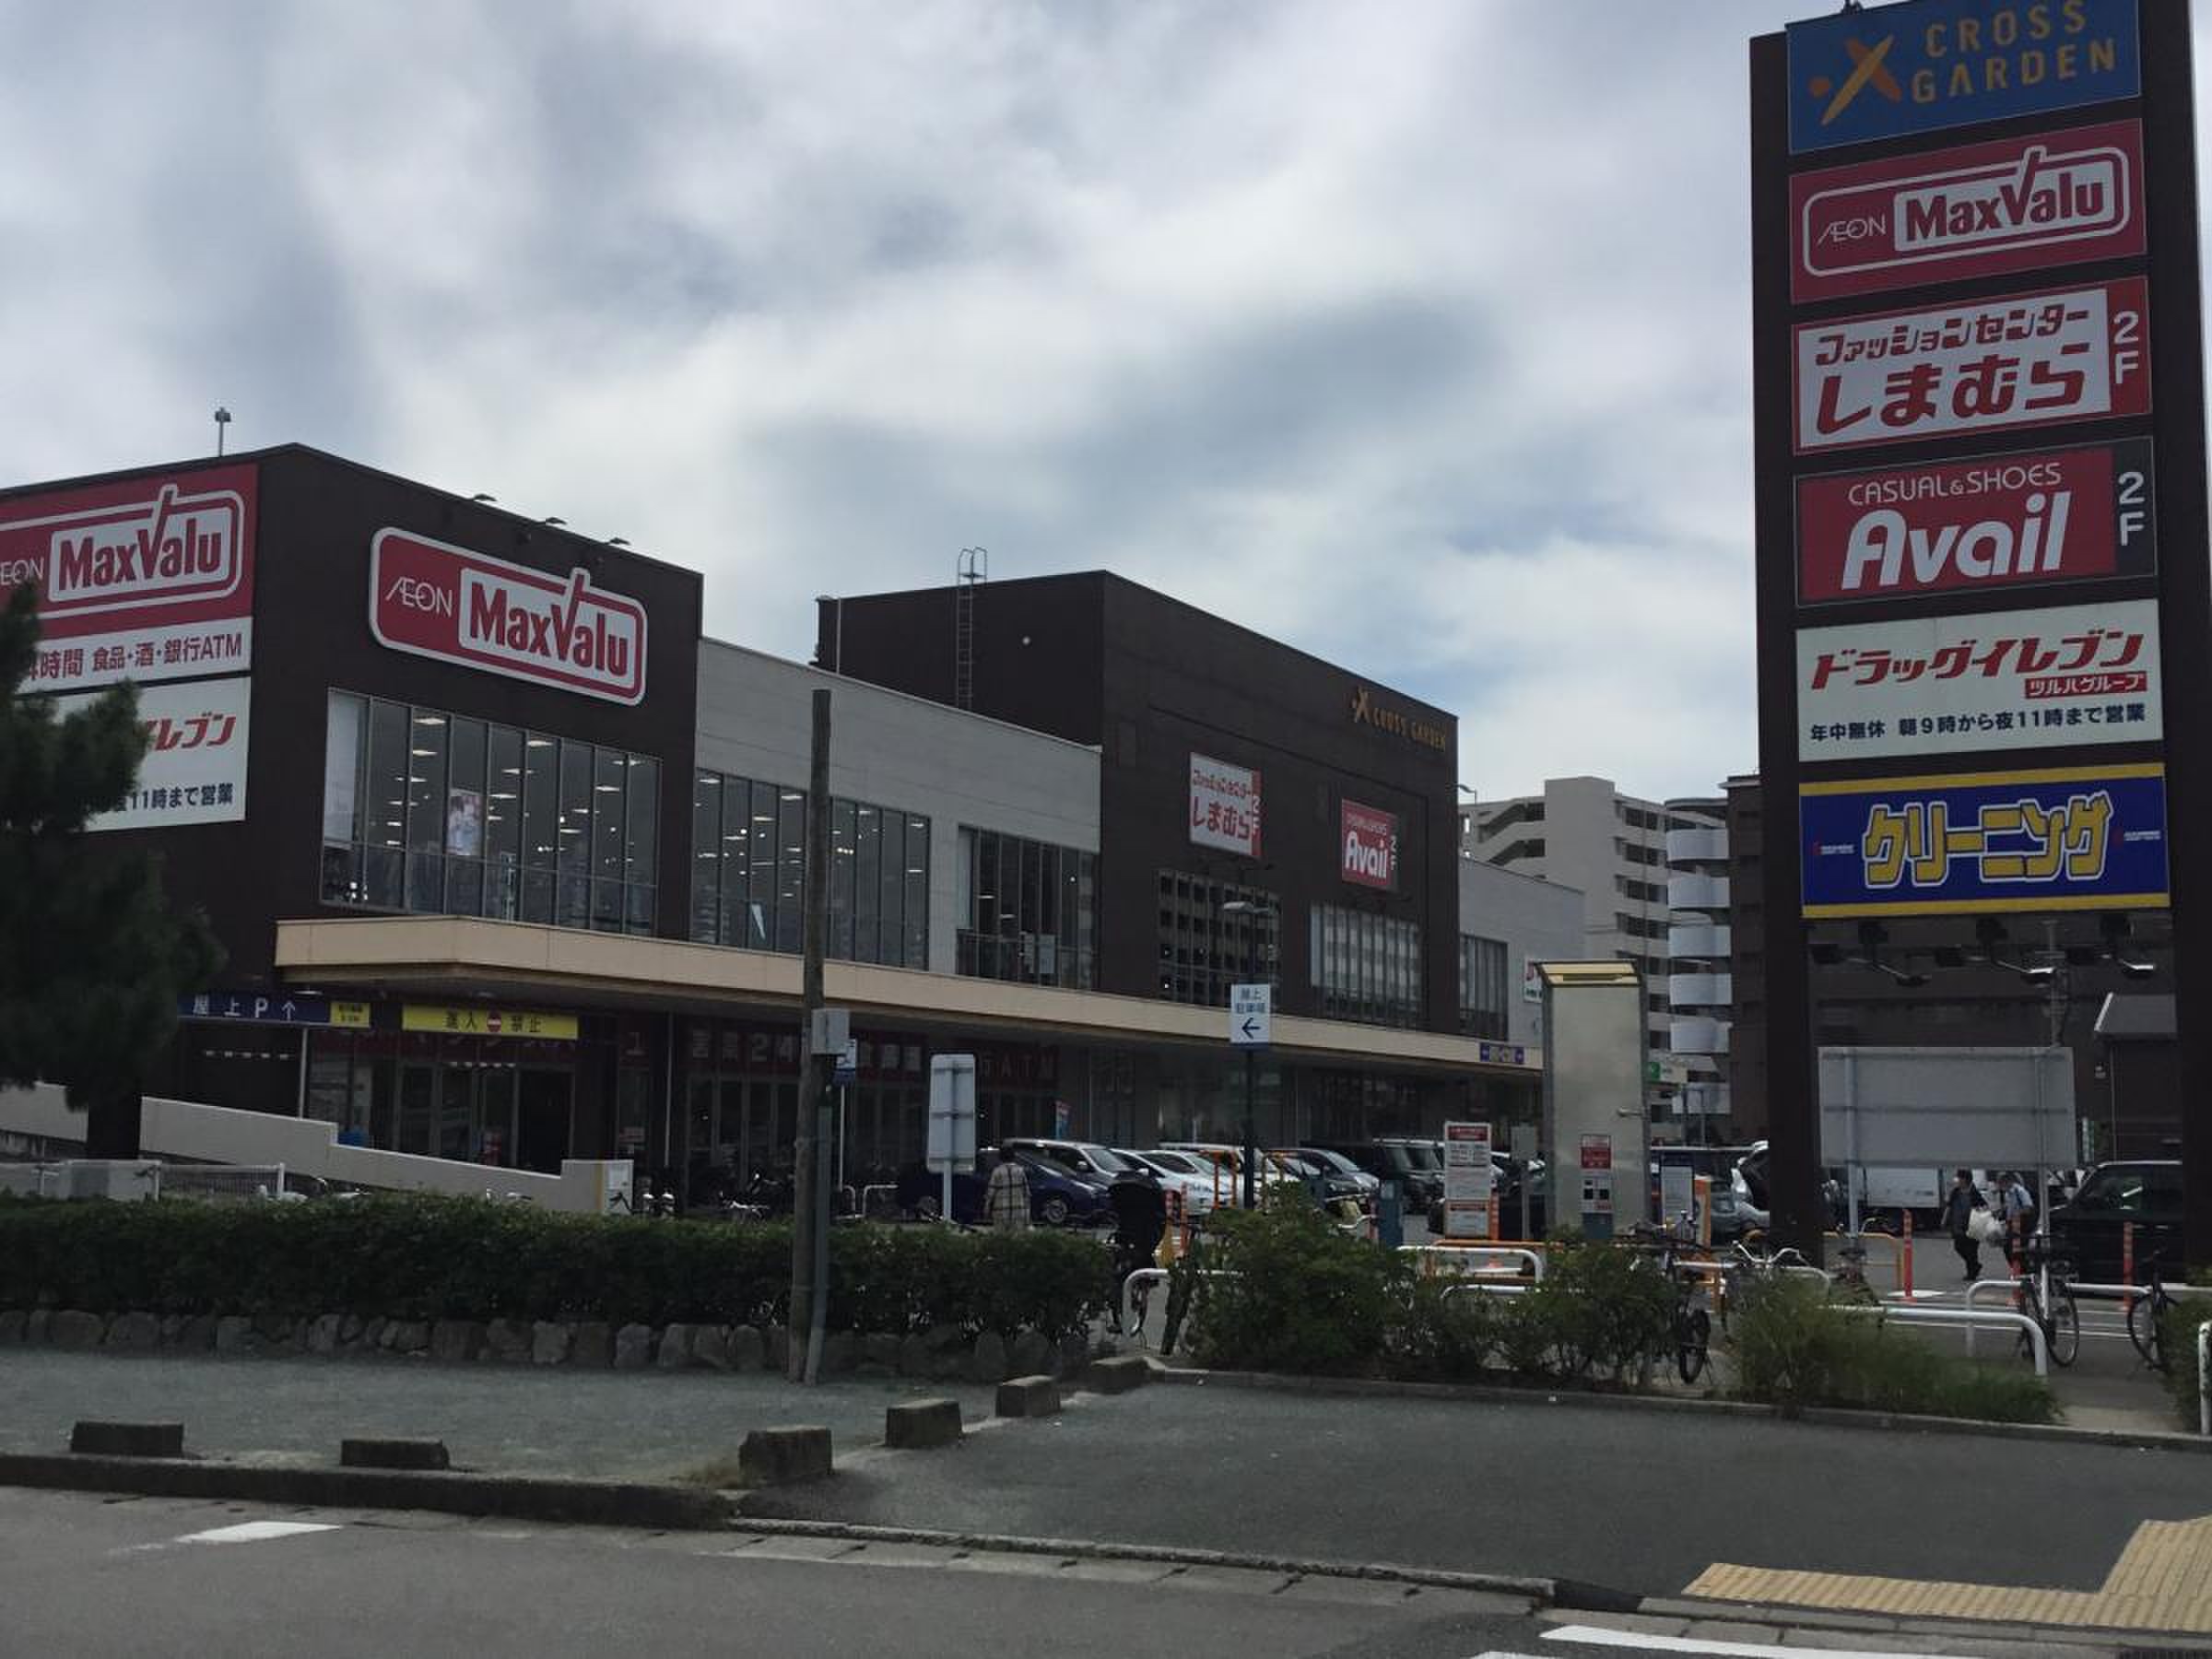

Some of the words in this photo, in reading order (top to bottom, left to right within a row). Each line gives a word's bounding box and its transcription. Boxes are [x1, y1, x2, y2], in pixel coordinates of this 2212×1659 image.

[1924, 0, 2087, 58] CROSS
[1911, 39, 2116, 104] GARDEN
[1905, 150, 2105, 242] MaxValu
[1815, 303, 2090, 367] ファッションセンター
[1816, 342, 2091, 435] しまむら
[59, 489, 222, 592] MaxValu
[1841, 491, 2072, 591] Avail
[469, 572, 629, 677] MaxValu
[1810, 629, 2145, 690] ドラッグイレブン
[145, 711, 237, 751] レブン
[1811, 720, 1887, 741] 年中無休
[1193, 794, 1251, 841] しまむら
[1862, 790, 2113, 889] クリーニング
[1344, 830, 1387, 879] Avail
